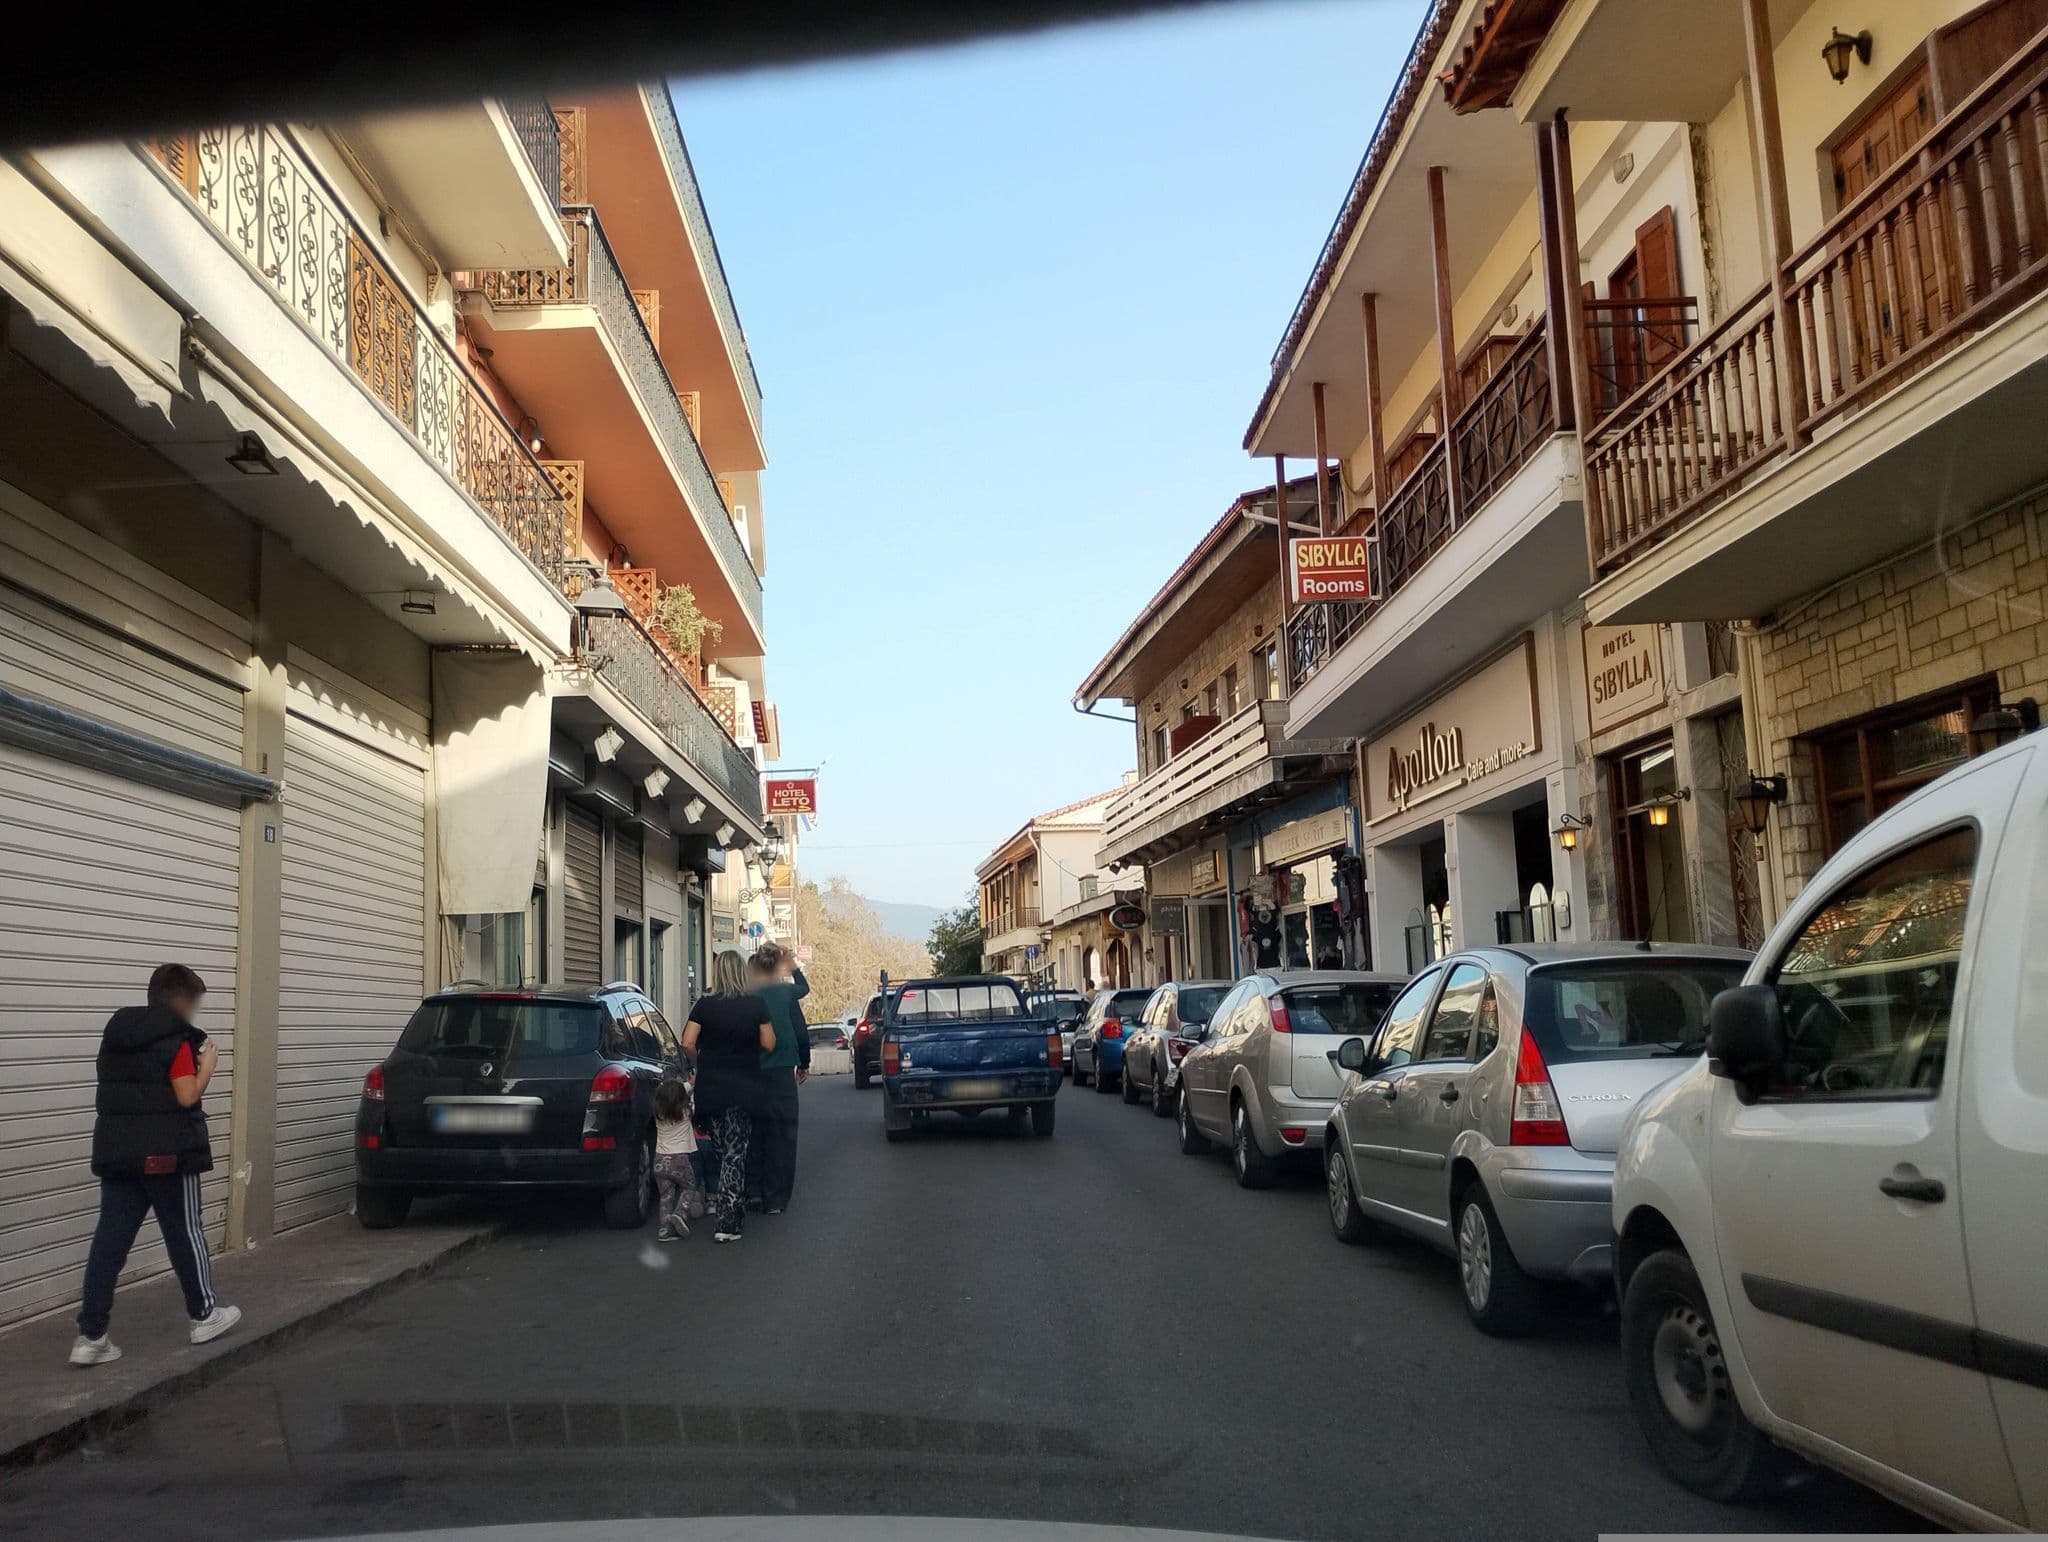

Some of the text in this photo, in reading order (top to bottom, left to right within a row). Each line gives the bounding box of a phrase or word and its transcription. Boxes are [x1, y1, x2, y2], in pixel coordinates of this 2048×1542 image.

[1298, 543, 1366, 568] SIBYLLA
[1302, 579, 1365, 594] Rooms
[1602, 630, 1635, 658] HOTEL
[1593, 649, 1653, 704] SIBYLLA
[1387, 721, 1464, 812] Apollon
[1466, 741, 1525, 782] Cafe and more
[772, 797, 810, 807] LETO
[774, 789, 808, 798] HOTEL
